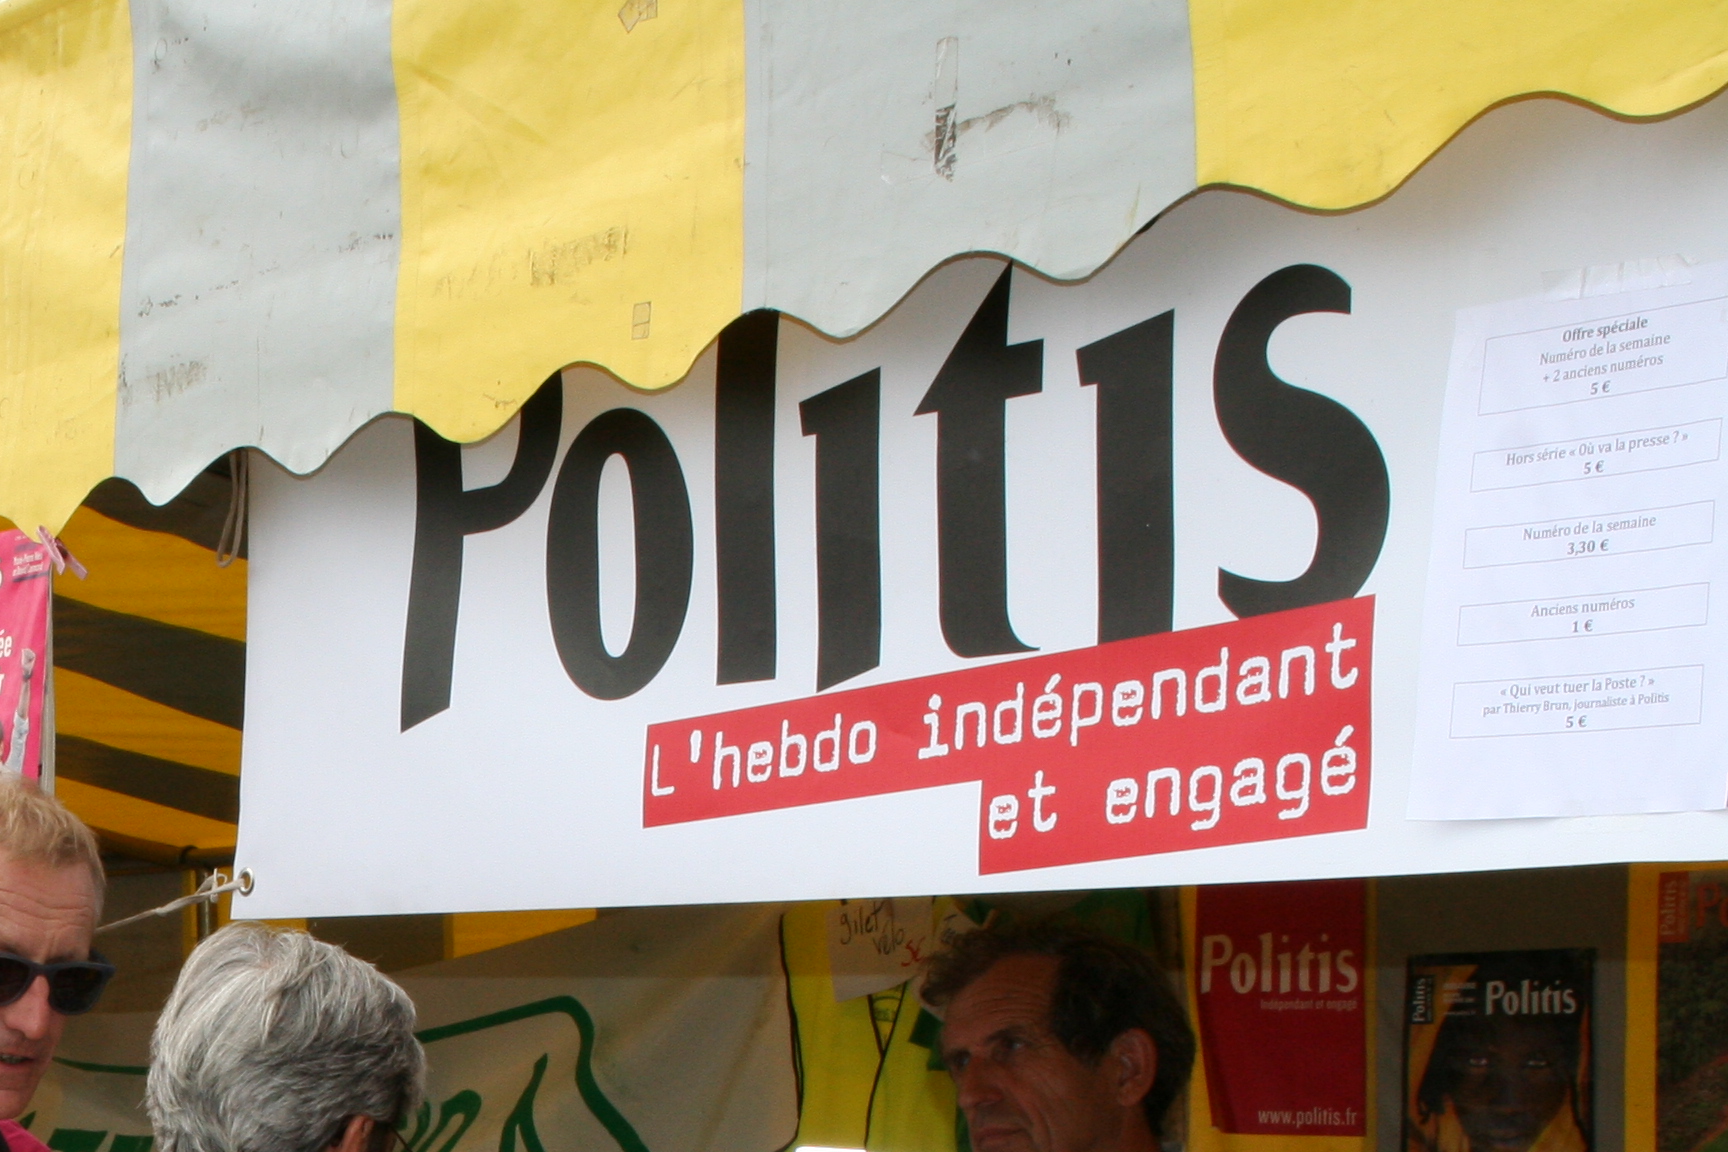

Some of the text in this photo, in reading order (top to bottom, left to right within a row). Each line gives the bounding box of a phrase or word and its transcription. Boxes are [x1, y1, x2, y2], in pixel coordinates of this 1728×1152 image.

[1562, 316, 1649, 343] Offre spéciale
[1539, 333, 1671, 366] Numéro de la semaine
[1552, 369, 1561, 383] 2
[1562, 363, 1607, 381] anciens
[1609, 353, 1664, 373] numéros
[1589, 380, 1611, 395] 5 €
[1505, 451, 1534, 467] Hors
[1536, 447, 1566, 463] série
[1578, 441, 1595, 457] Où
[1597, 443, 1612, 454] va
[1615, 438, 1625, 453] la
[1628, 433, 1670, 454] presse
[1583, 460, 1605, 475] 5 €
[400, 258, 1391, 735] Politis
[1522, 515, 1657, 542] Numéro de la semaine
[1566, 538, 1609, 557] 3,30 €
[1530, 597, 1636, 618] Anciens numéros
[1572, 619, 1593, 633] 1 €
[1509, 683, 1531, 700] Qui
[1533, 683, 1560, 695] veut
[1563, 681, 1588, 693] tuer
[1591, 678, 1602, 692] la
[1604, 676, 1637, 691] Poste
[650, 622, 1359, 798] L'hebdo indépendant
[1482, 704, 1501, 718] par
[1637, 691, 1670, 706] Politis
[1565, 715, 1587, 729] 5 €
[988, 724, 1358, 840] et engagé
[1200, 931, 1358, 995] Politis
[1411, 977, 1426, 1023] Politis
[1485, 978, 1577, 1016] Politis
[1257, 1106, 1358, 1128] www.politis.fr
